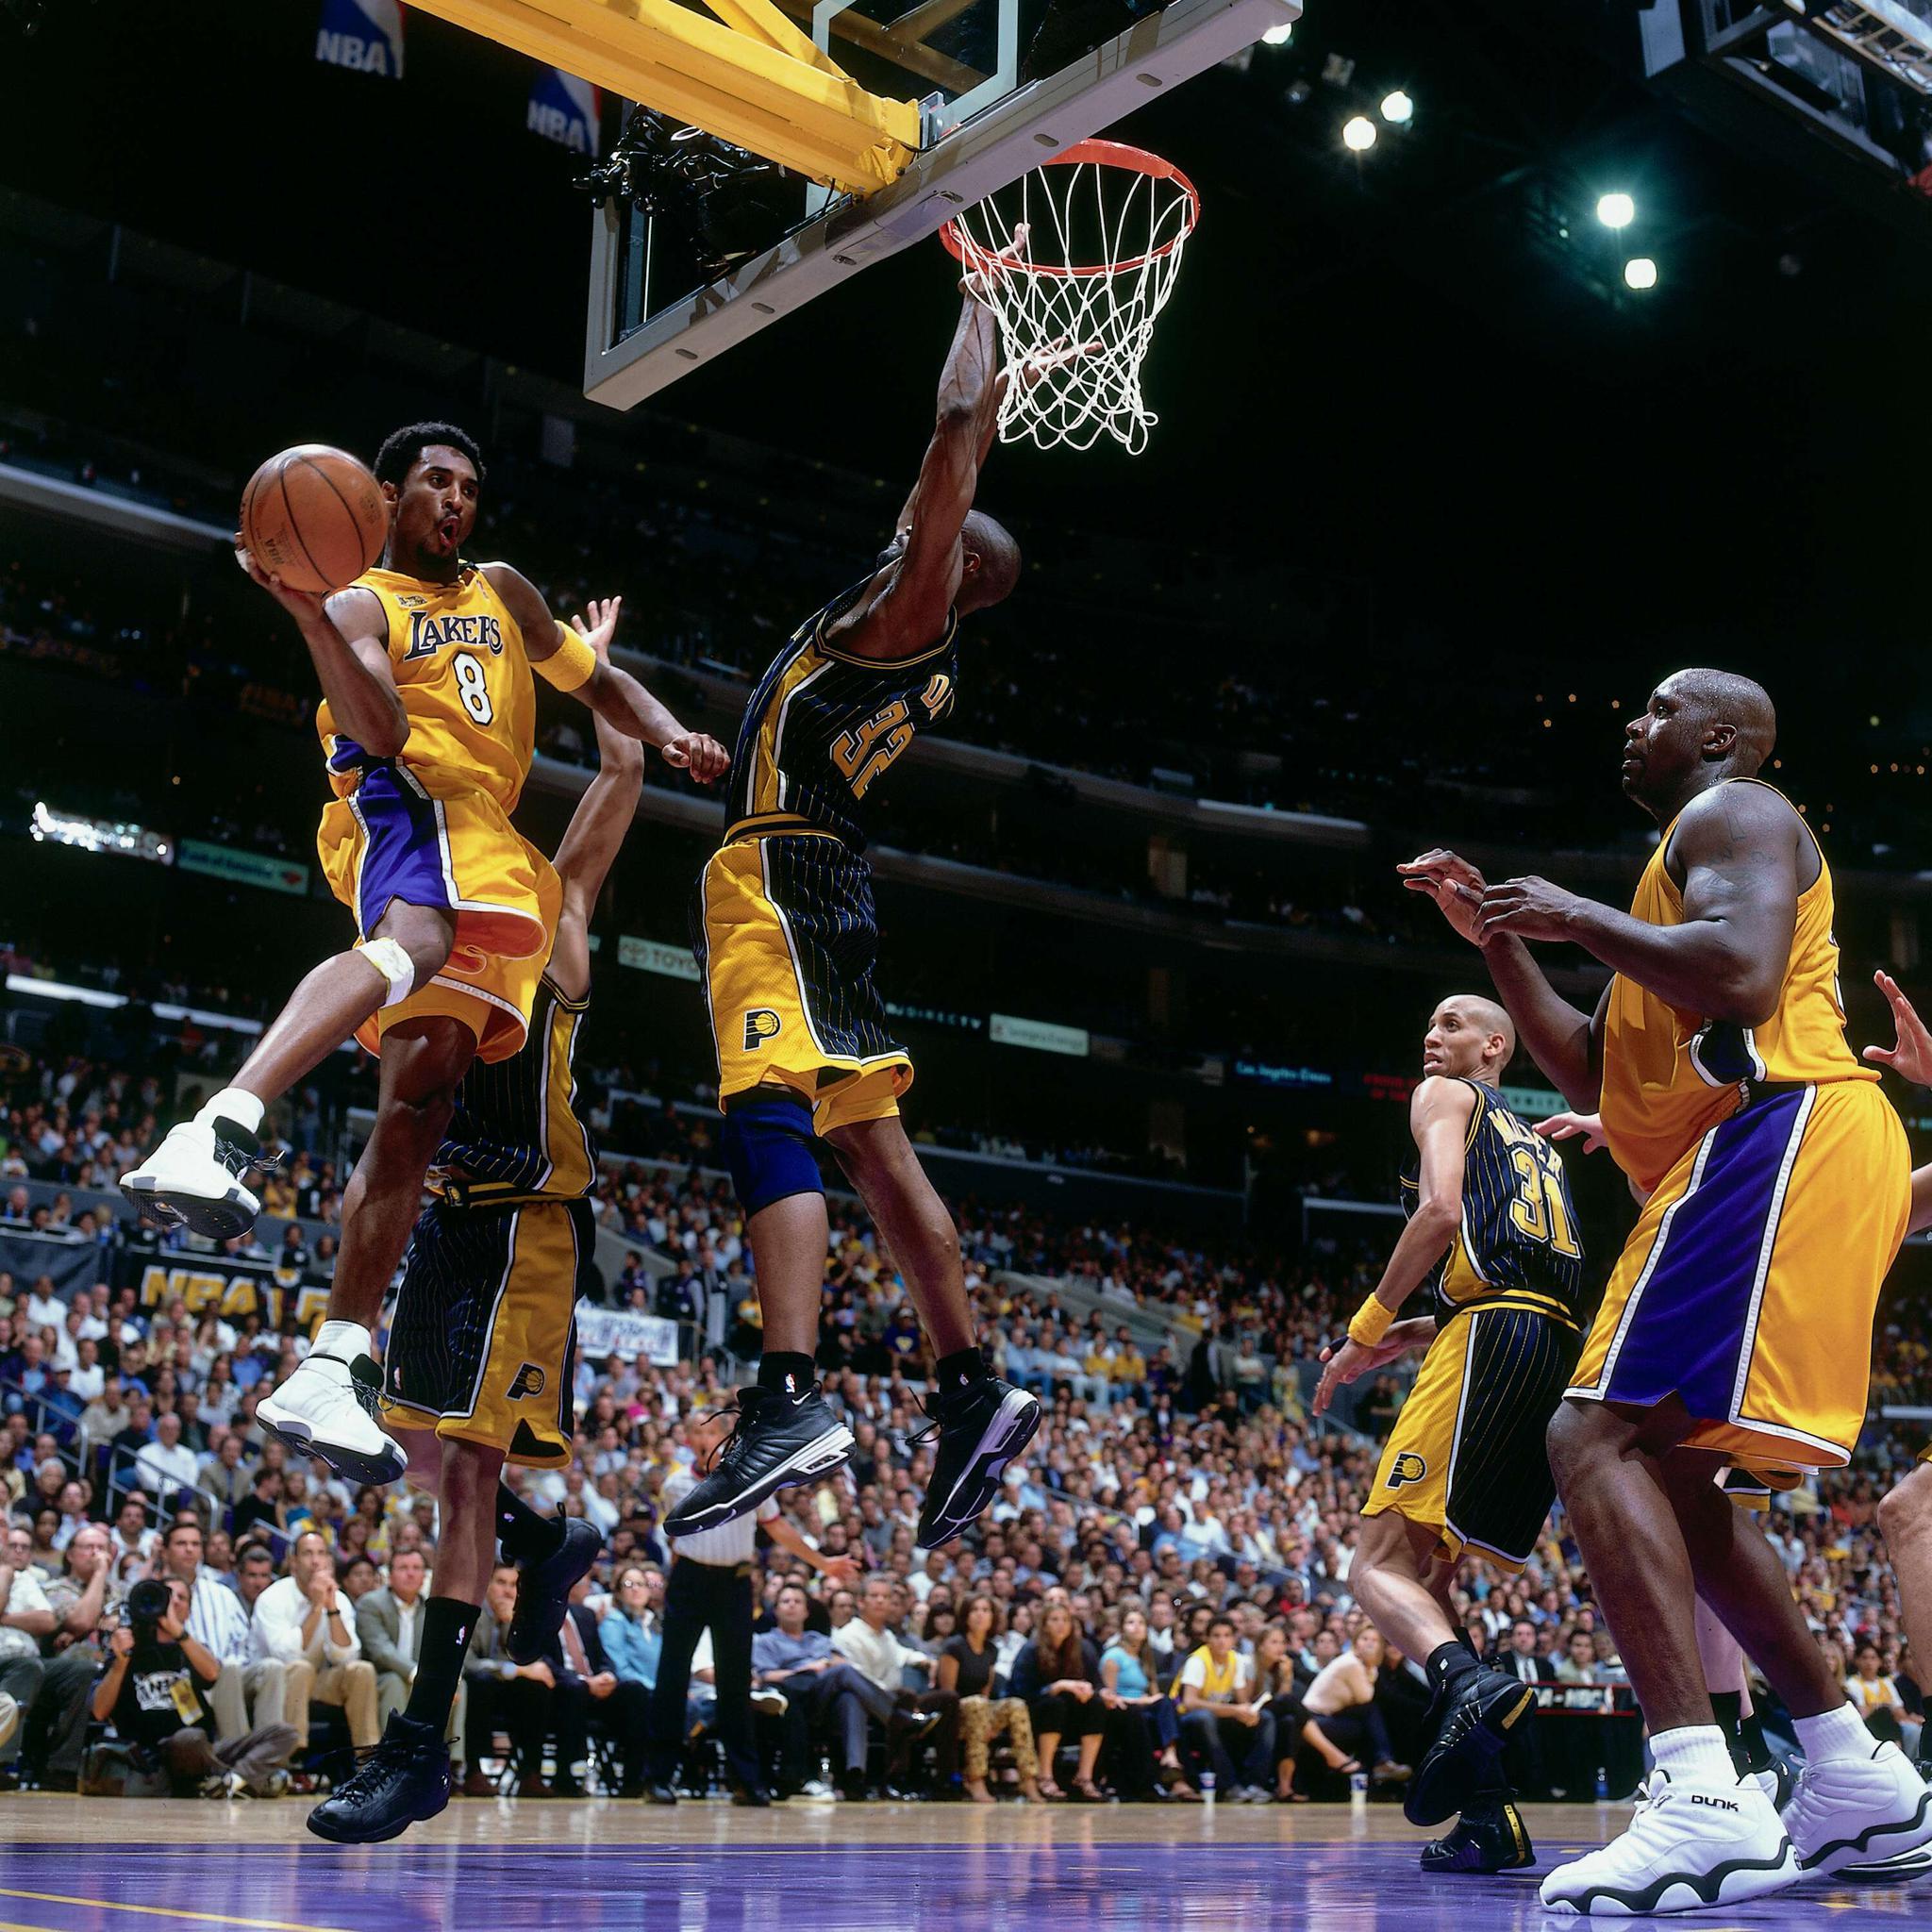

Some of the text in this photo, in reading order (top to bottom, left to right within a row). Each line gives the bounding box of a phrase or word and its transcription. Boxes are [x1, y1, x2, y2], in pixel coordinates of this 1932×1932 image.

[315, 28, 387, 76] NBA
[526, 98, 587, 155] NBA
[404, 609, 504, 662] LAKERS
[452, 650, 494, 726] 8
[830, 699, 915, 800] 32
[1509, 1147, 1582, 1259] 31
[142, 1264, 258, 1318] NBA
